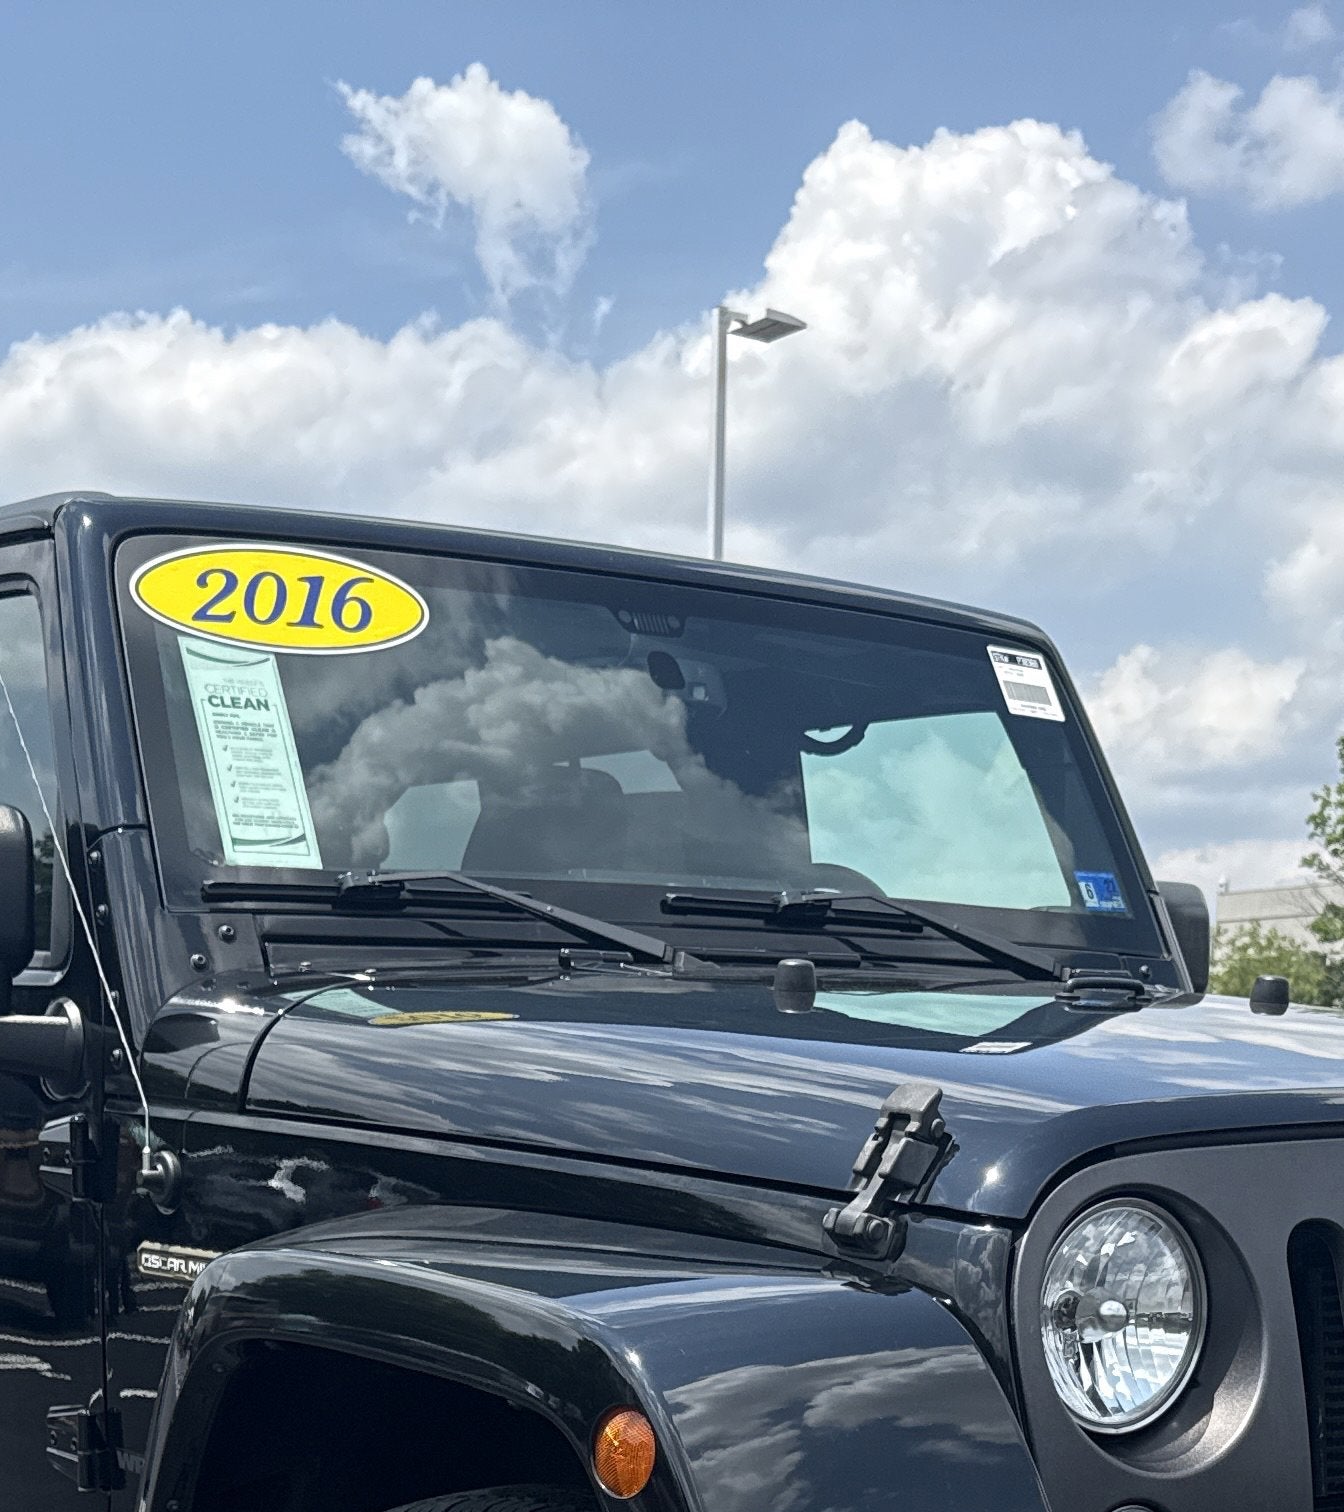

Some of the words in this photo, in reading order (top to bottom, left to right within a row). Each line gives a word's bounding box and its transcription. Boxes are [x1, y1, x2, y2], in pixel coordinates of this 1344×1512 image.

[192, 568, 374, 633] 2016
[204, 683, 268, 698] CERTIFIED
[208, 695, 270, 711] CLEAN
[1084, 883, 1094, 899] 6
